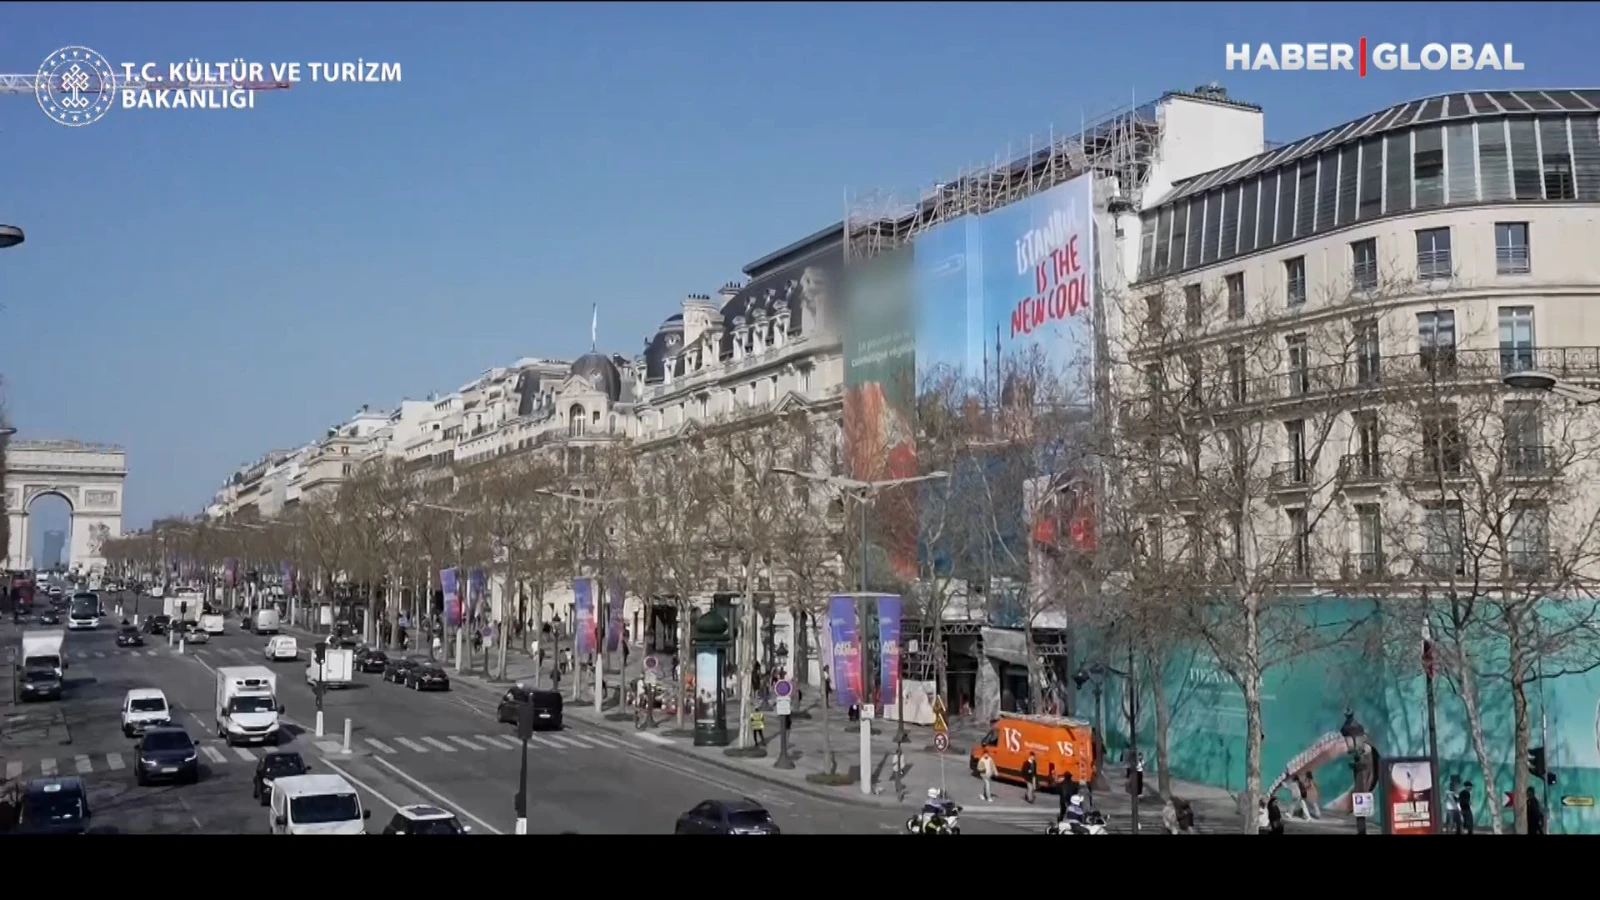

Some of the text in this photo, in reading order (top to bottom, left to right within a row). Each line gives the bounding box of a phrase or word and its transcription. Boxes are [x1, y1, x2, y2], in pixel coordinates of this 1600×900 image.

[1036, 233, 1081, 295] IS THE
[1011, 272, 1090, 340] NEW COOL
[1004, 727, 1022, 752] VS
[1056, 741, 1074, 757] VS
